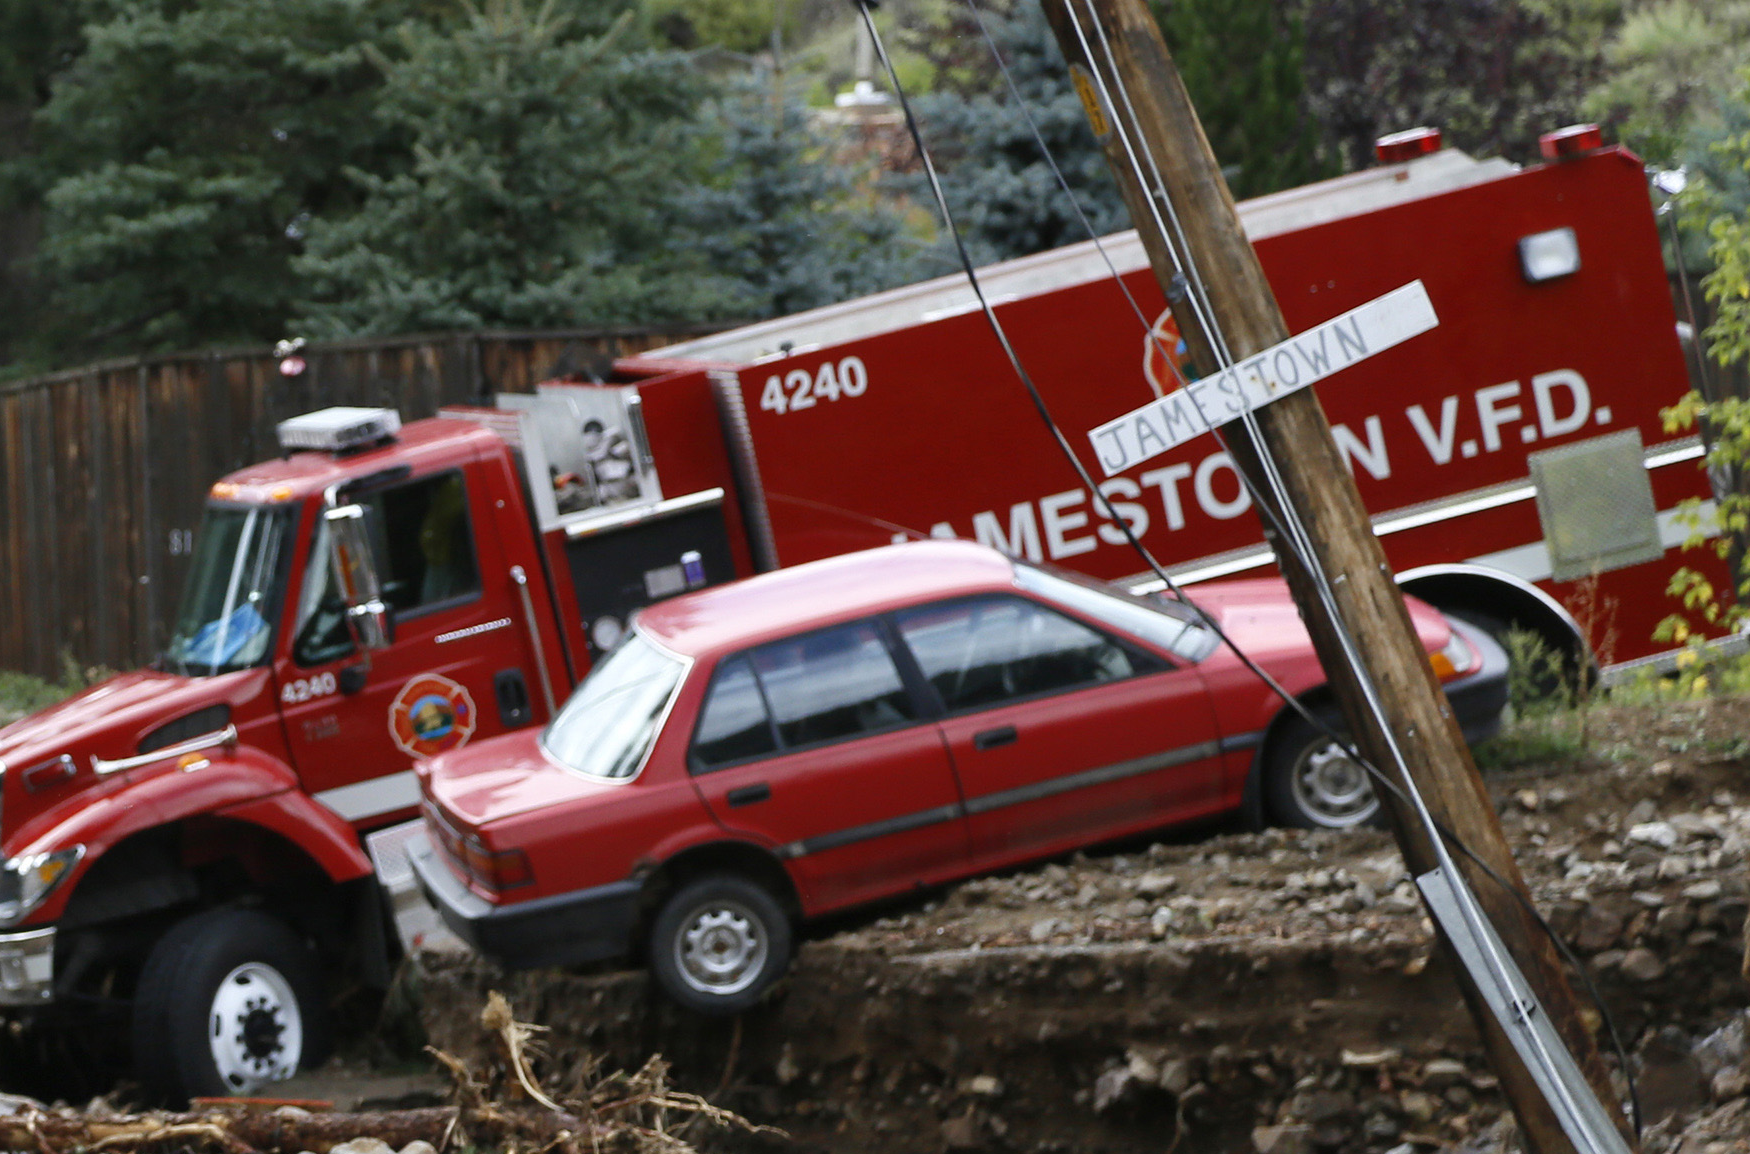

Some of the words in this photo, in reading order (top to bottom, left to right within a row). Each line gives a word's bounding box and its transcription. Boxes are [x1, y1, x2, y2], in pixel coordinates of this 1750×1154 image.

[760, 356, 868, 415] 4240
[1096, 315, 1369, 471] JAMESTOWN
[891, 413, 1391, 564] MESTON
[1406, 368, 1612, 466] V.F.D.
[281, 671, 336, 703] 4240
